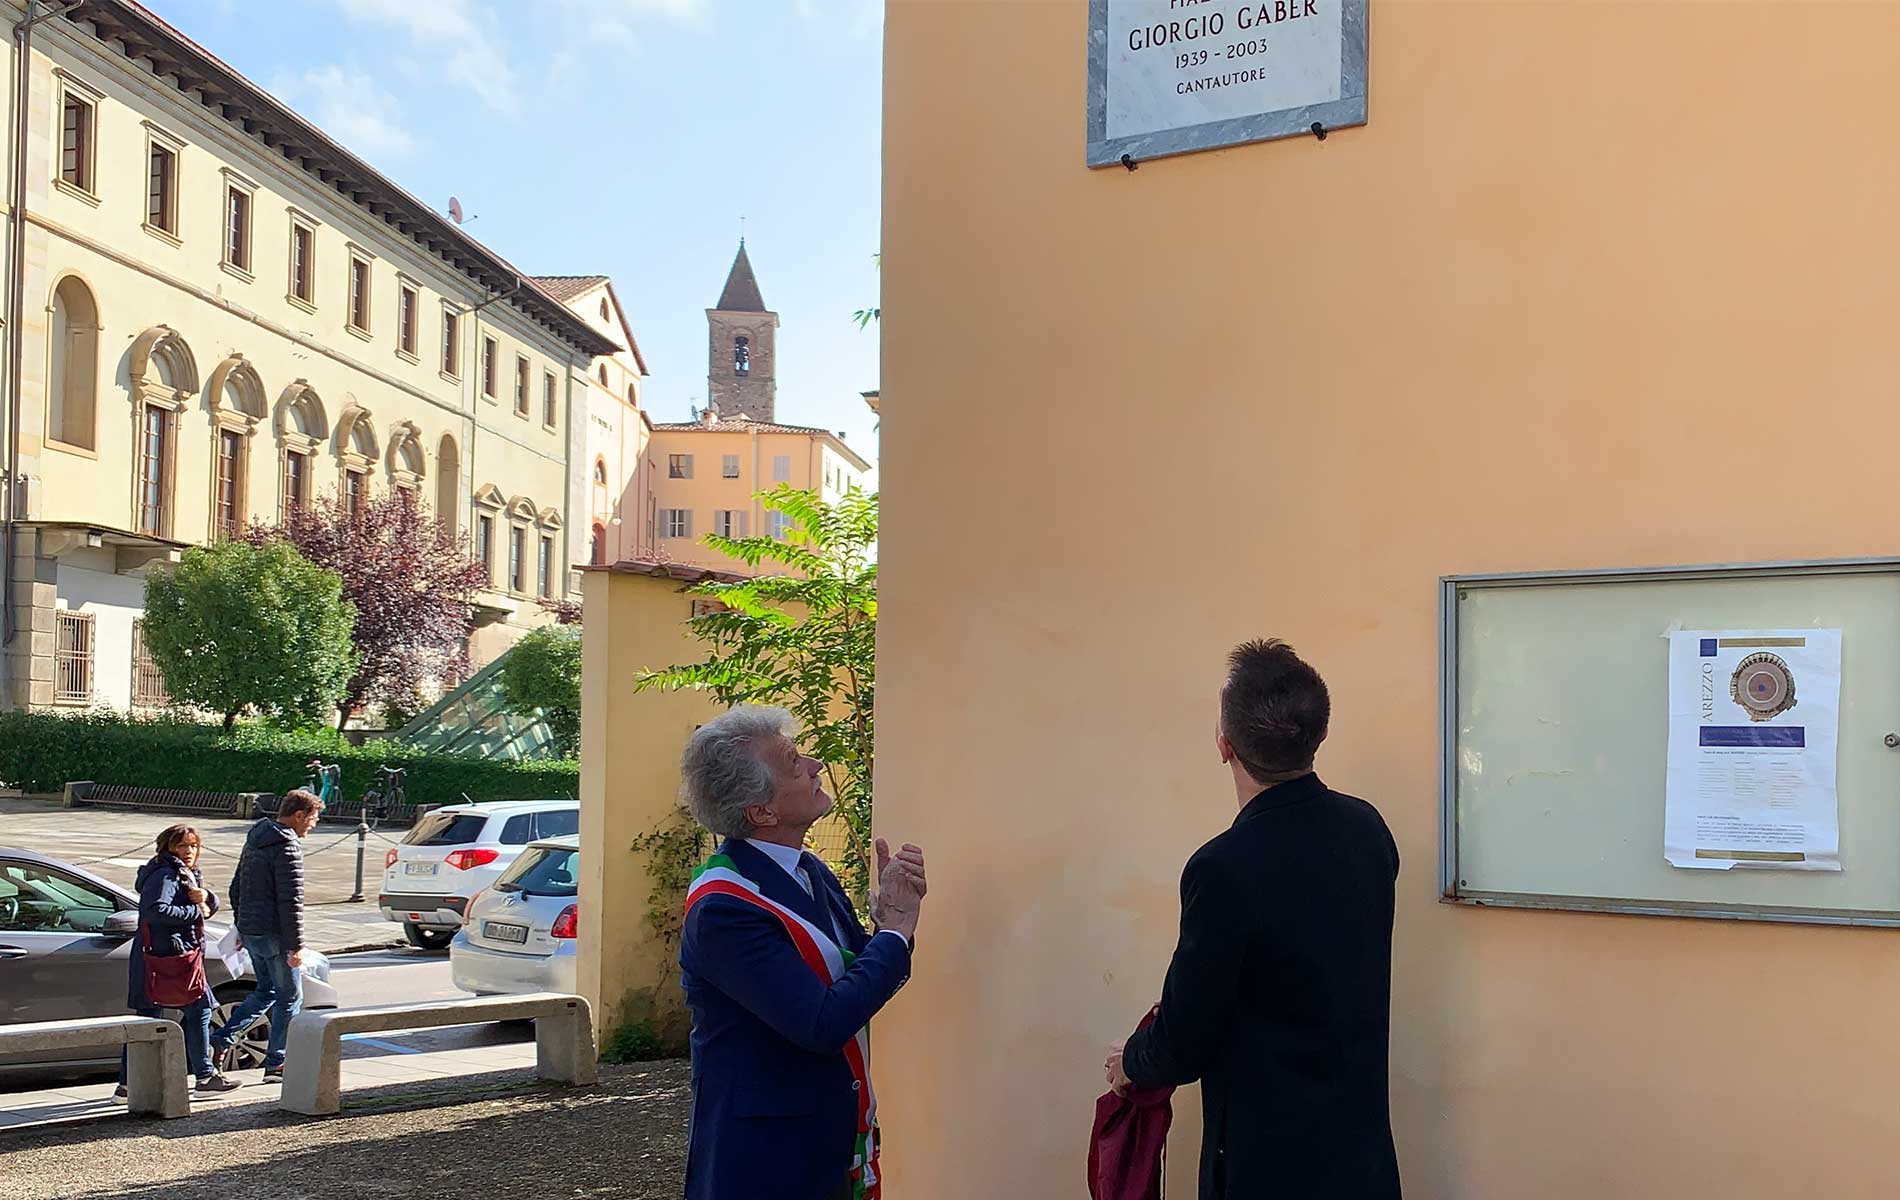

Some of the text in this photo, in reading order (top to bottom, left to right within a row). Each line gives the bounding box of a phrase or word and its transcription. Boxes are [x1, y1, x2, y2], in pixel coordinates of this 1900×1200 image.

[1129, 0, 1318, 50] GIORGIO GABER
[1175, 50, 1208, 69] 1939
[1227, 38, 1268, 59] 2003
[1176, 67, 1266, 94] CANTAUTORE
[1702, 662, 1713, 722] AREZZO
